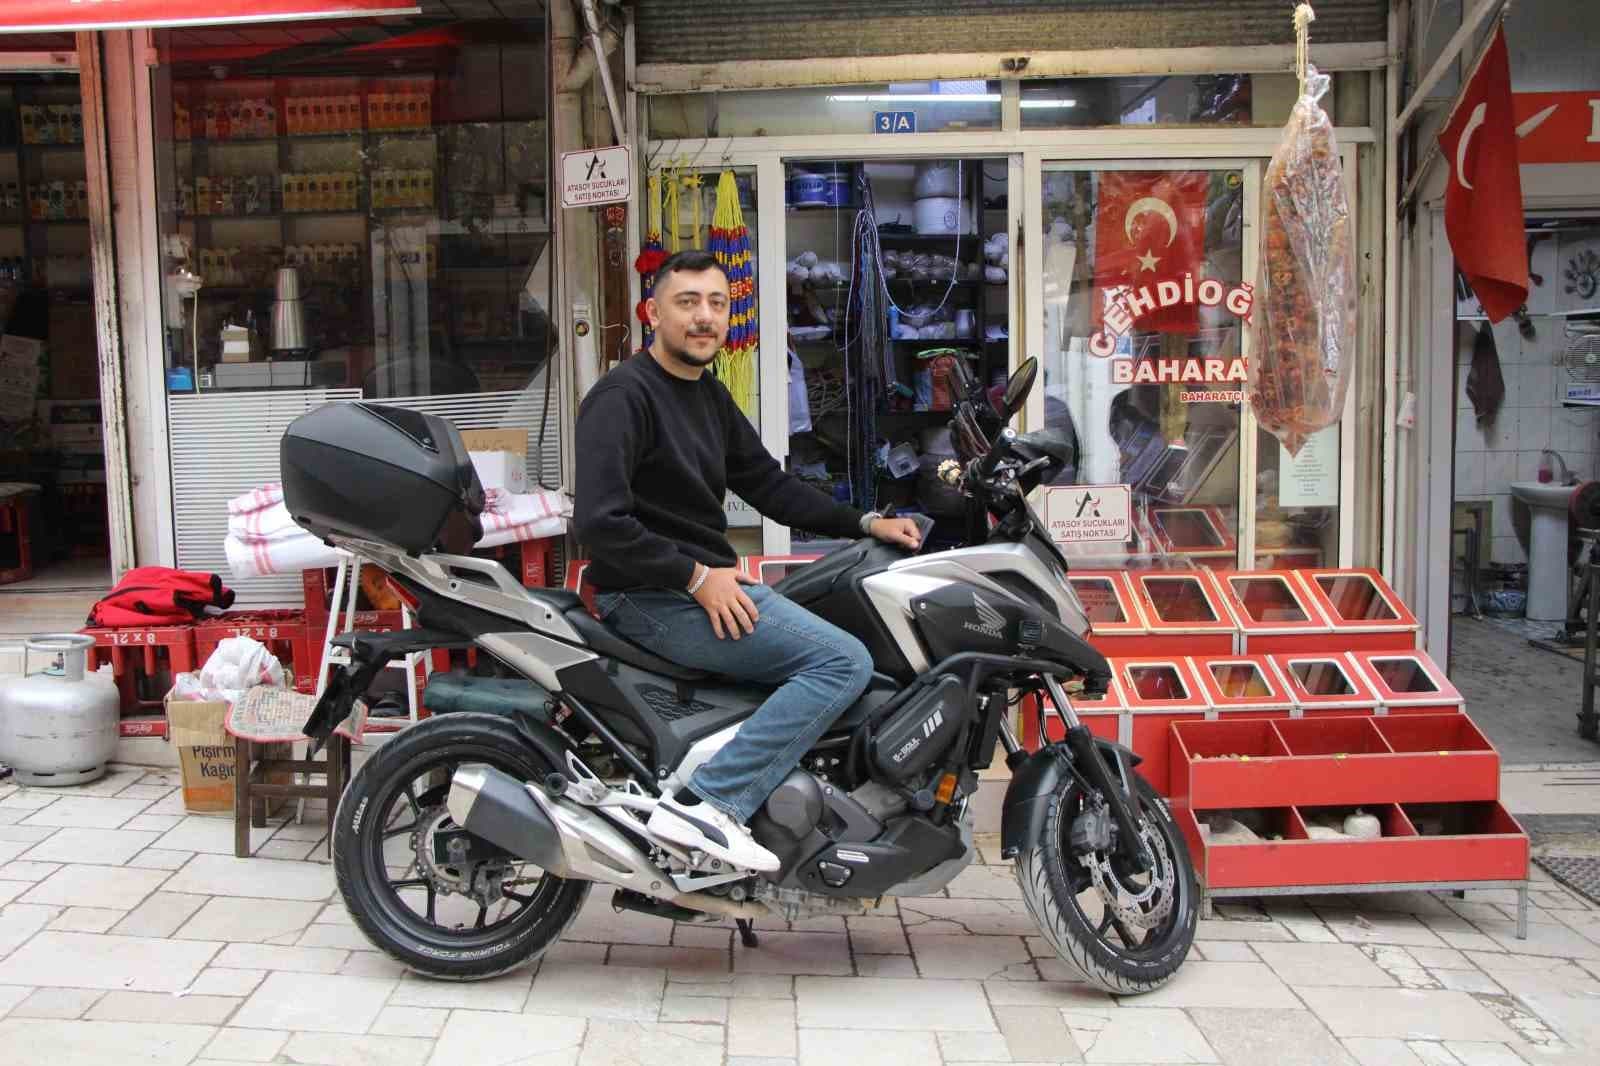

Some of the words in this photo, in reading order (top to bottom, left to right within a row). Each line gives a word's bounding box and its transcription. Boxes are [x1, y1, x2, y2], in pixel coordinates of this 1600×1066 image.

[881, 113, 910, 131] 3/A
[1112, 357, 1249, 385] BAHARA
[1051, 520, 1081, 529] ATASOY
[1083, 519, 1125, 528] SUCUKLARI
[1083, 529, 1116, 538] NOKTASI
[963, 621, 1004, 640] HONDA
[146, 633, 156, 646] 8
